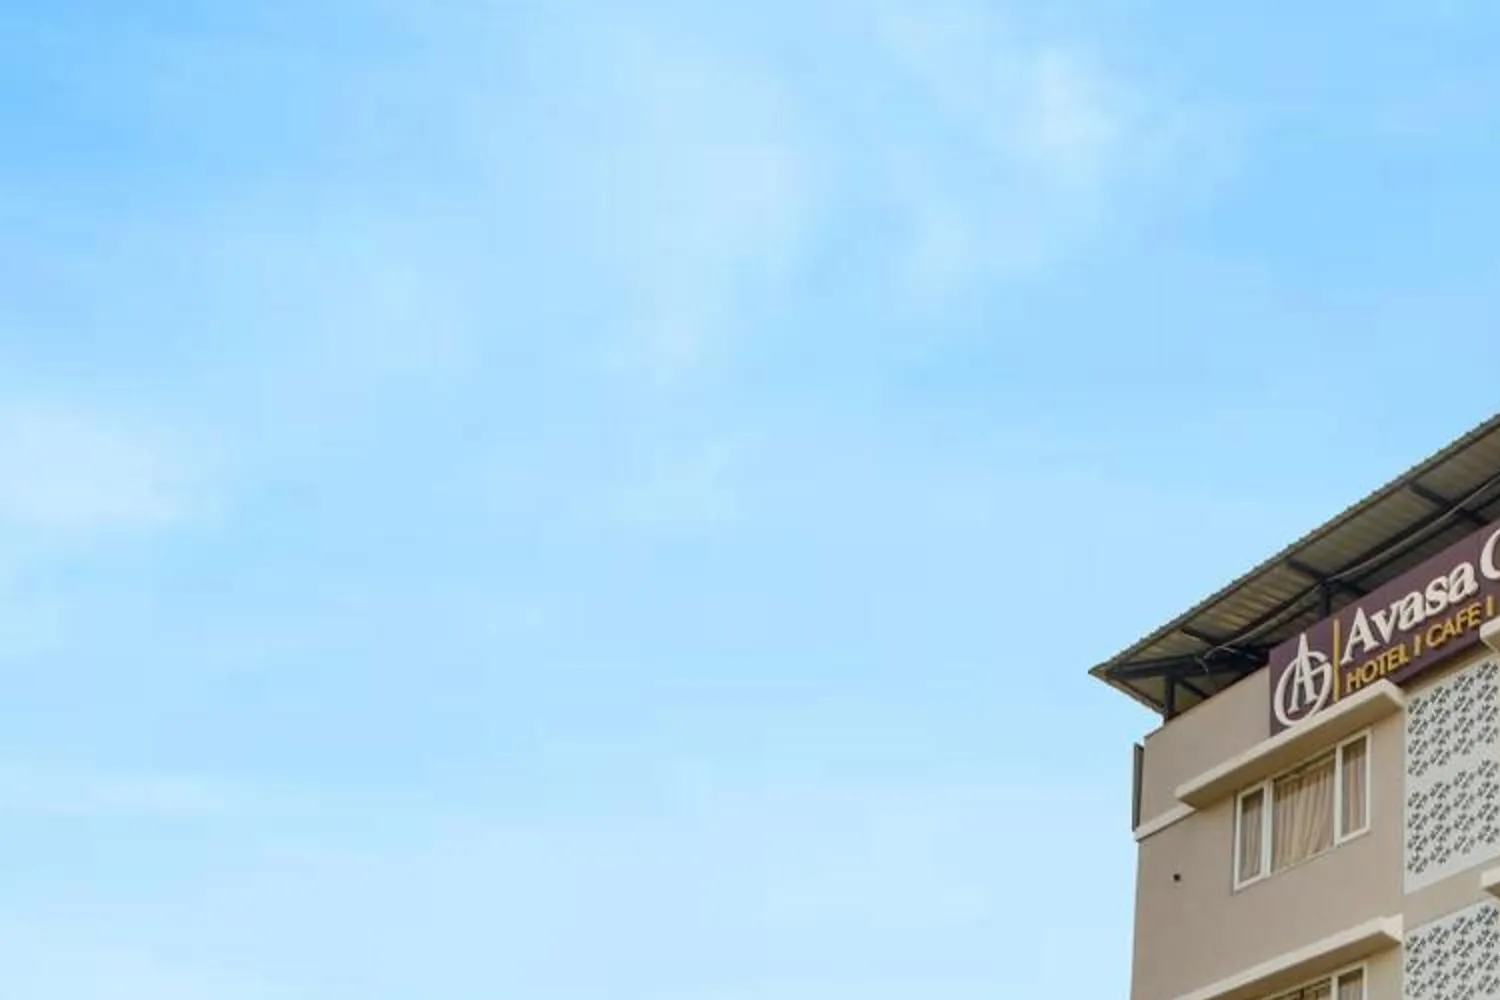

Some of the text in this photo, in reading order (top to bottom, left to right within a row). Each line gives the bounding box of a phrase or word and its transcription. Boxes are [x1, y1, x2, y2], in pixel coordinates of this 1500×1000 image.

[1341, 562, 1478, 665] Avasa
[1346, 643, 1409, 693] HOTEL
[1426, 602, 1481, 647] CAFE
